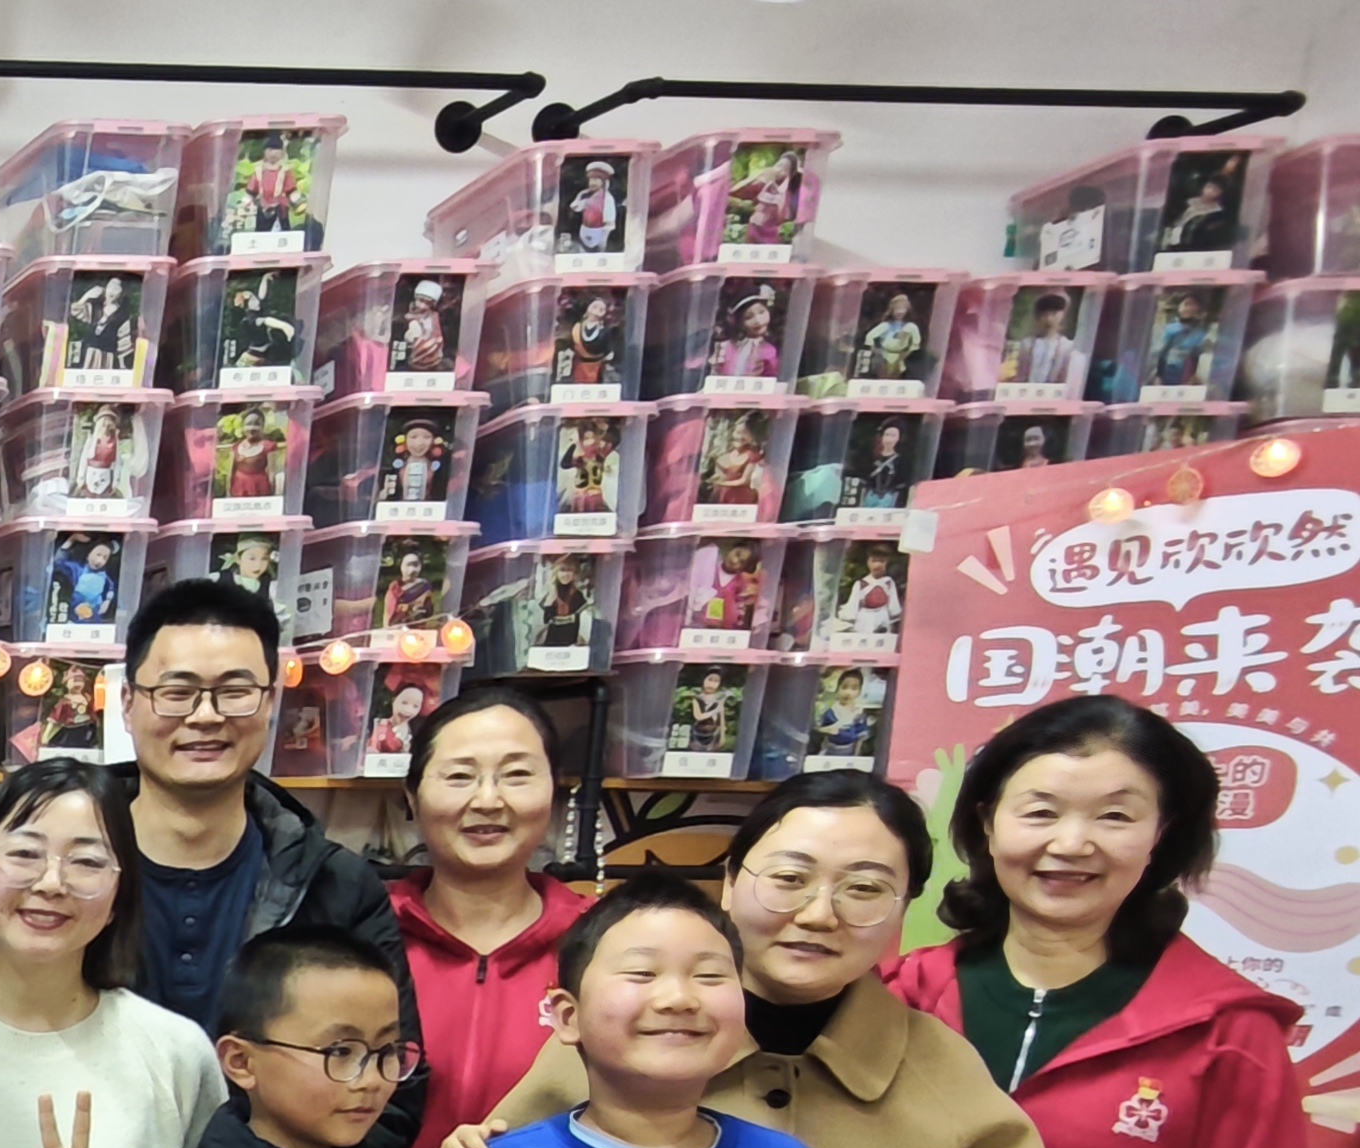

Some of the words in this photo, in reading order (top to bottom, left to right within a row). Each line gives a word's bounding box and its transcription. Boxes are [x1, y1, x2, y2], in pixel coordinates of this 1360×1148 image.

[1047, 510, 1354, 594] 遇见欣欣然
